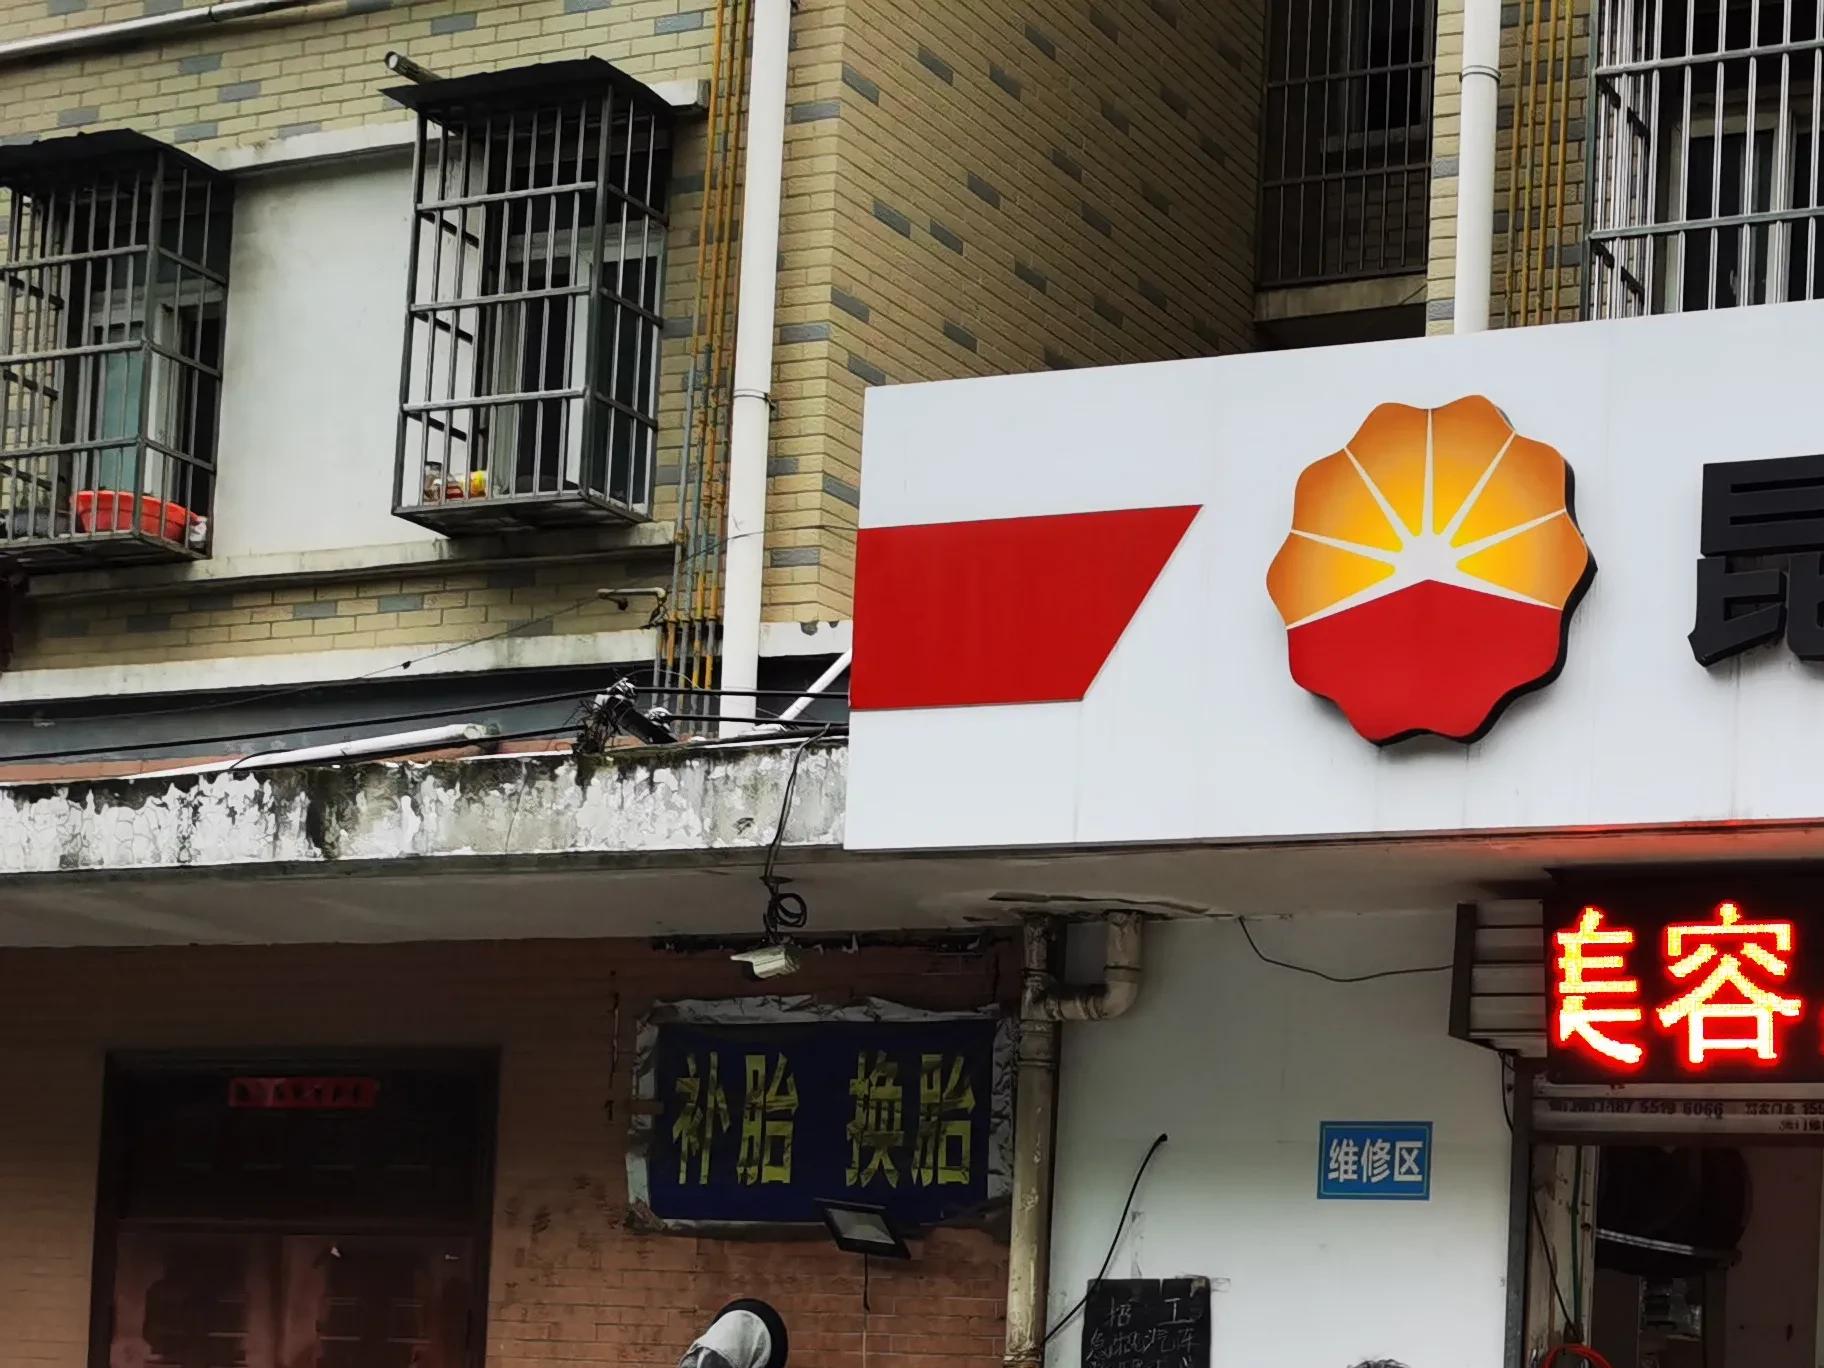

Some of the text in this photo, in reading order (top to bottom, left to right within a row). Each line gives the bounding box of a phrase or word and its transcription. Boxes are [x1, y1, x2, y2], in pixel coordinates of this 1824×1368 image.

[672, 1050, 976, 1187] 补胎 换胎
[1327, 1139, 1423, 1184] 维修区
